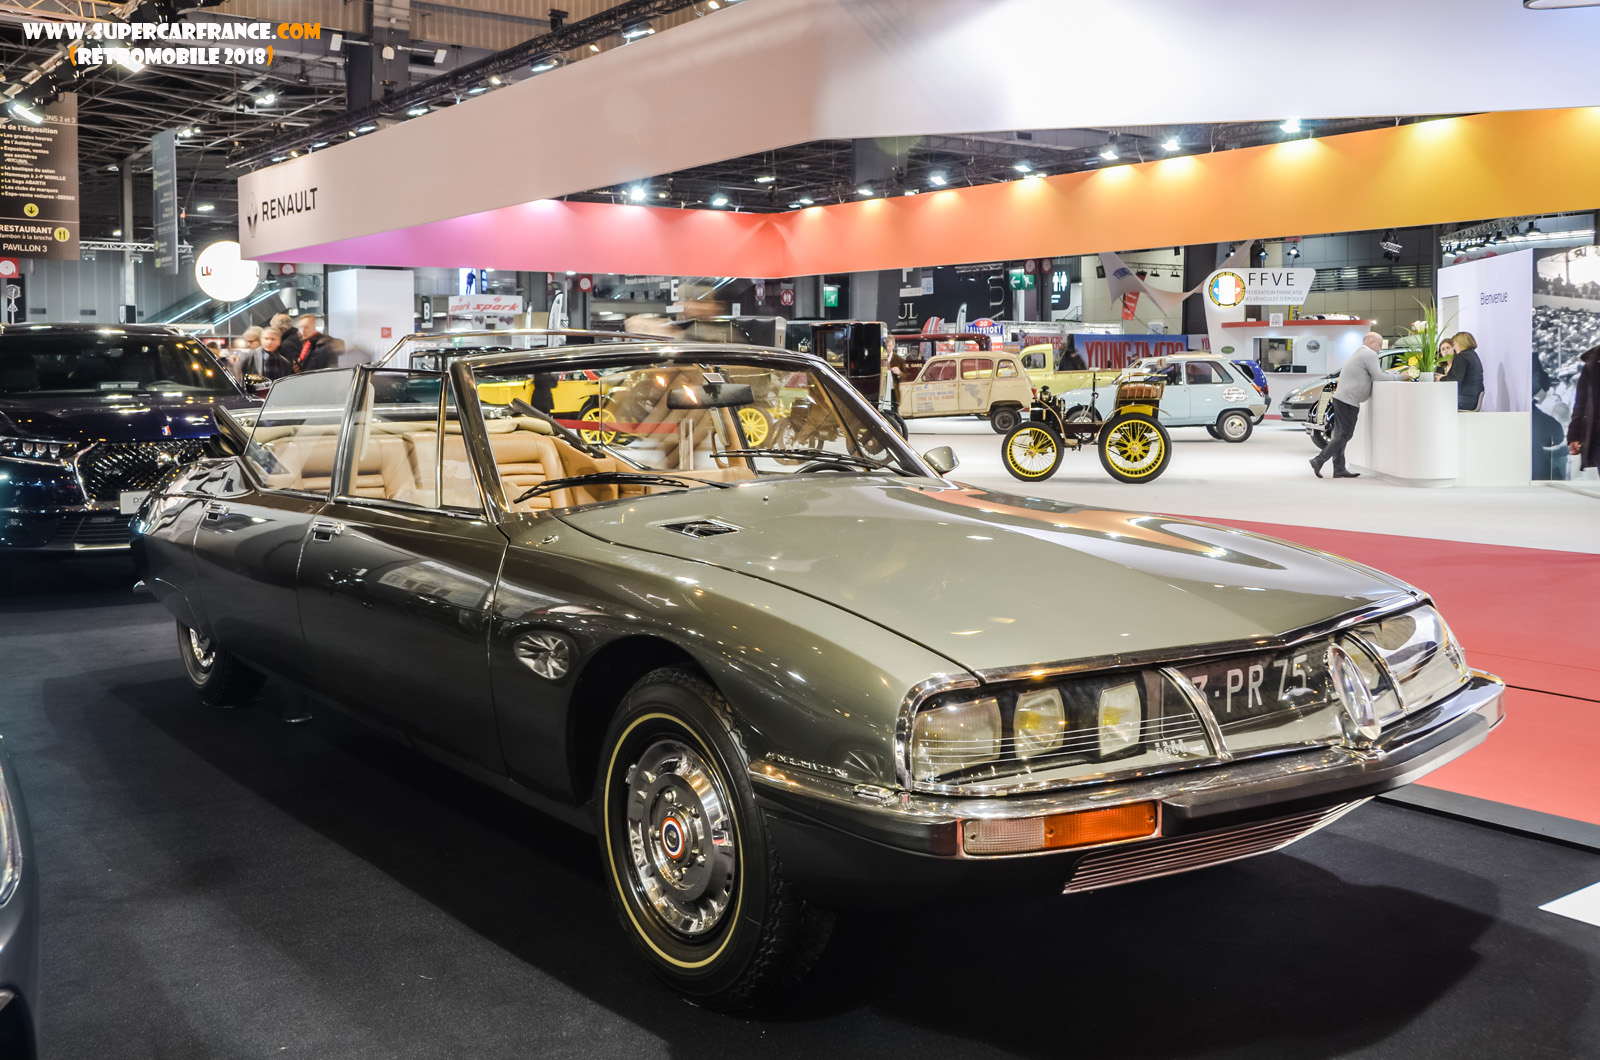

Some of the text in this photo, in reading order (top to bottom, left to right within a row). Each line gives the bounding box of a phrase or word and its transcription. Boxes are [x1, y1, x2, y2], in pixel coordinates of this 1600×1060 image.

[18, 125, 58, 134] l'Exposition
[262, 187, 318, 222] RENAULT
[0, 224, 52, 234] RESTAURANT
[3, 243, 41, 252] PAVILLON
[1248, 272, 1295, 286] FFVE
[1480, 292, 1507, 305] Bienvenue
[424, 302, 430, 320] B
[473, 303, 520, 312] spark
[965, 324, 1002, 334] RALLYSTORY
[1273, 654, 1307, 702] 75
